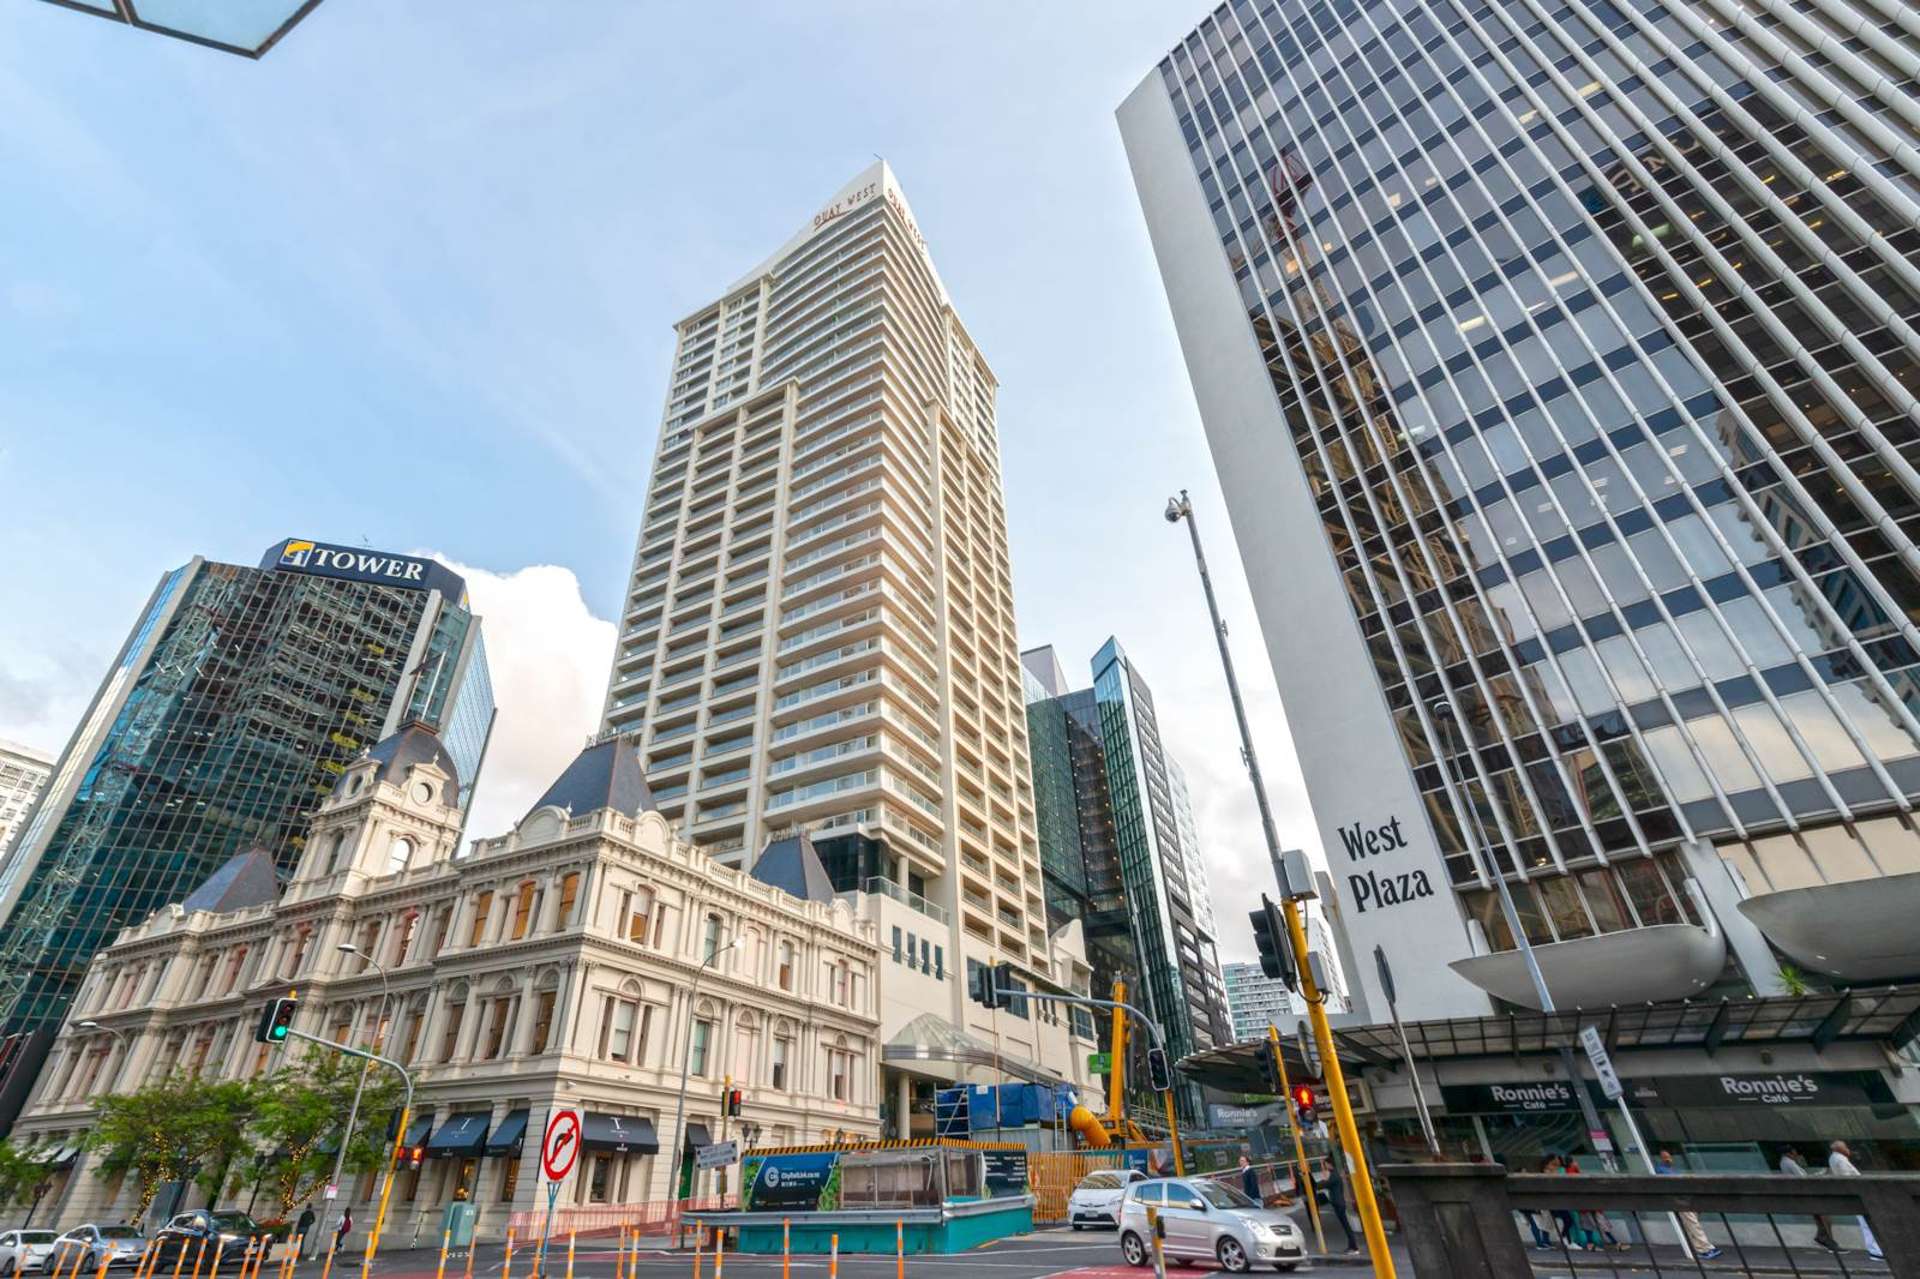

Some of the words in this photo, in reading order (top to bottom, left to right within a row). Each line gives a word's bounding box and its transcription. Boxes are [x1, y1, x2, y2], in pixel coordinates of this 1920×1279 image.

[847, 182, 877, 205] WEST
[315, 549, 424, 581] TOWER
[1337, 815, 1408, 862] West
[1348, 869, 1435, 913] Plaza
[1490, 1083, 1570, 1101] Ronnie's
[1720, 1075, 1819, 1094] Ronnie's
